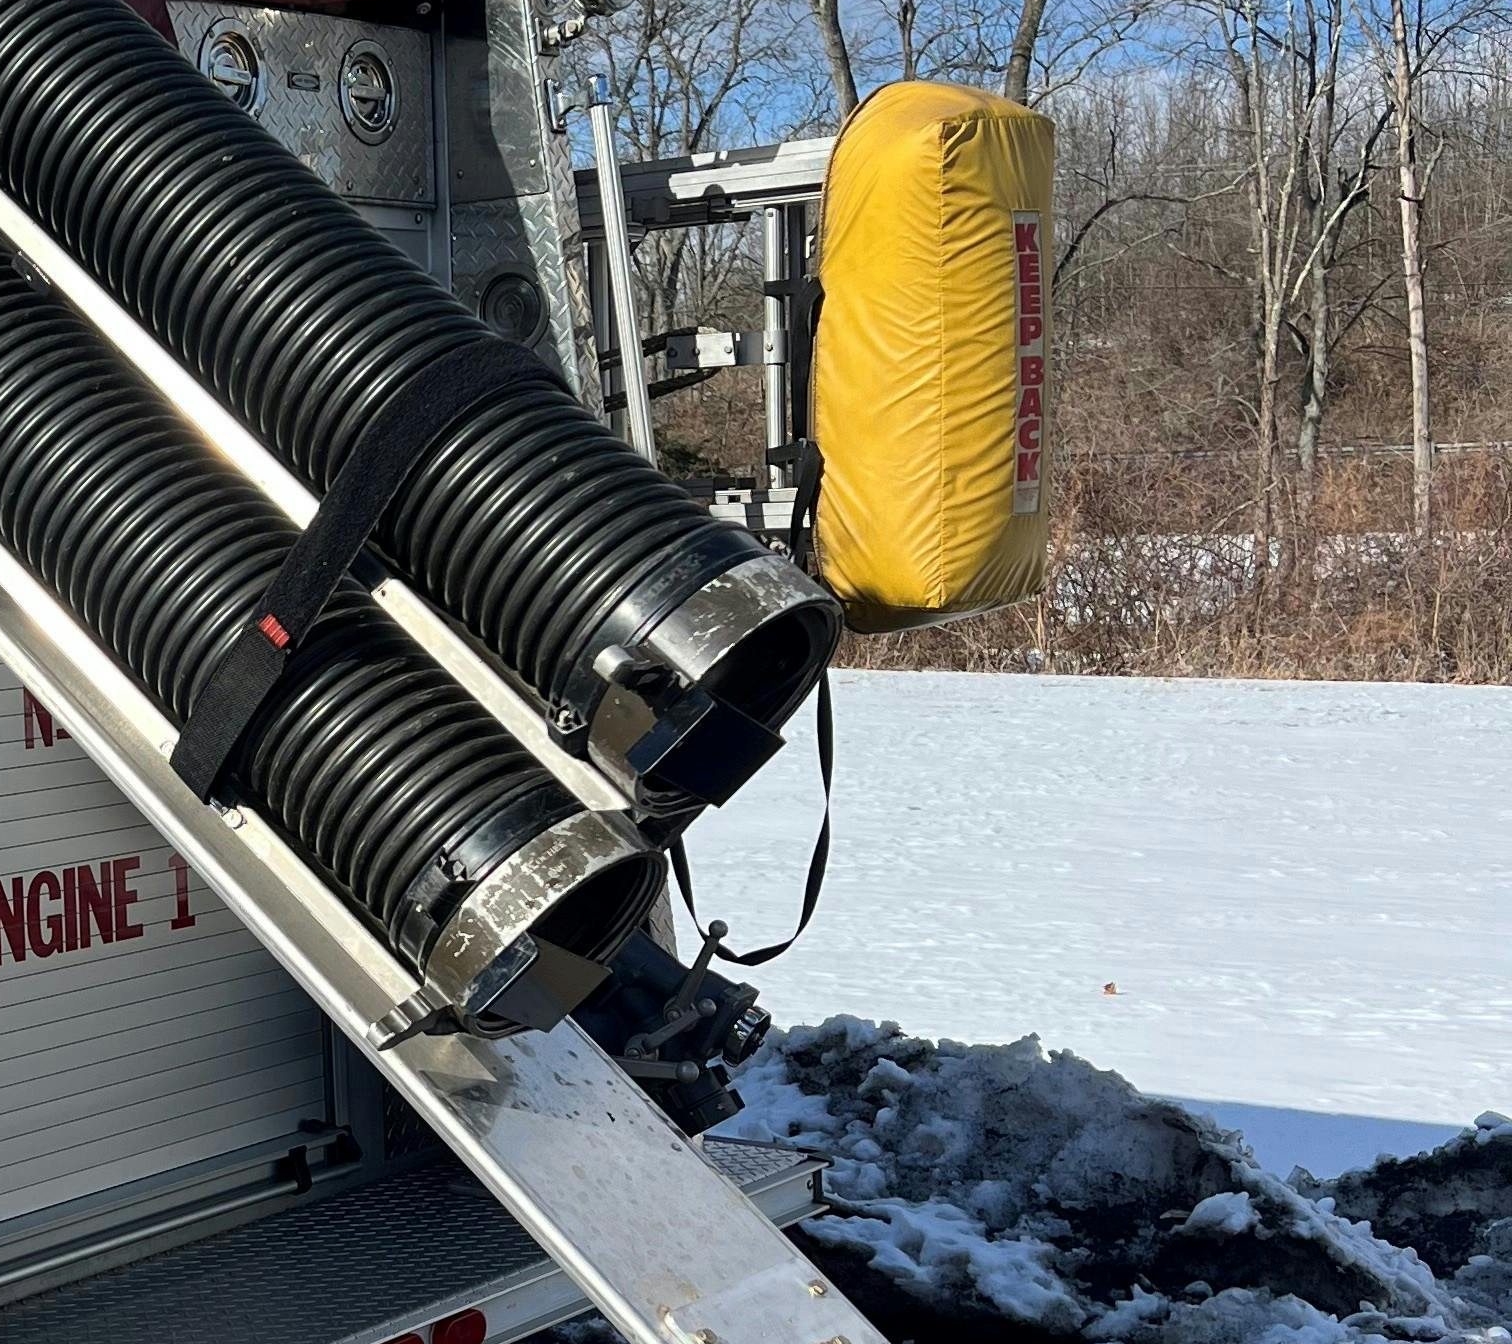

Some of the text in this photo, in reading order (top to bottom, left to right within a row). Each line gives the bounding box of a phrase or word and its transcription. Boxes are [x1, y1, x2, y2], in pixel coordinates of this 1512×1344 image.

[1014, 223, 1042, 347] KEEP
[1017, 356, 1044, 482] BACK
[168, 851, 196, 931] 1
